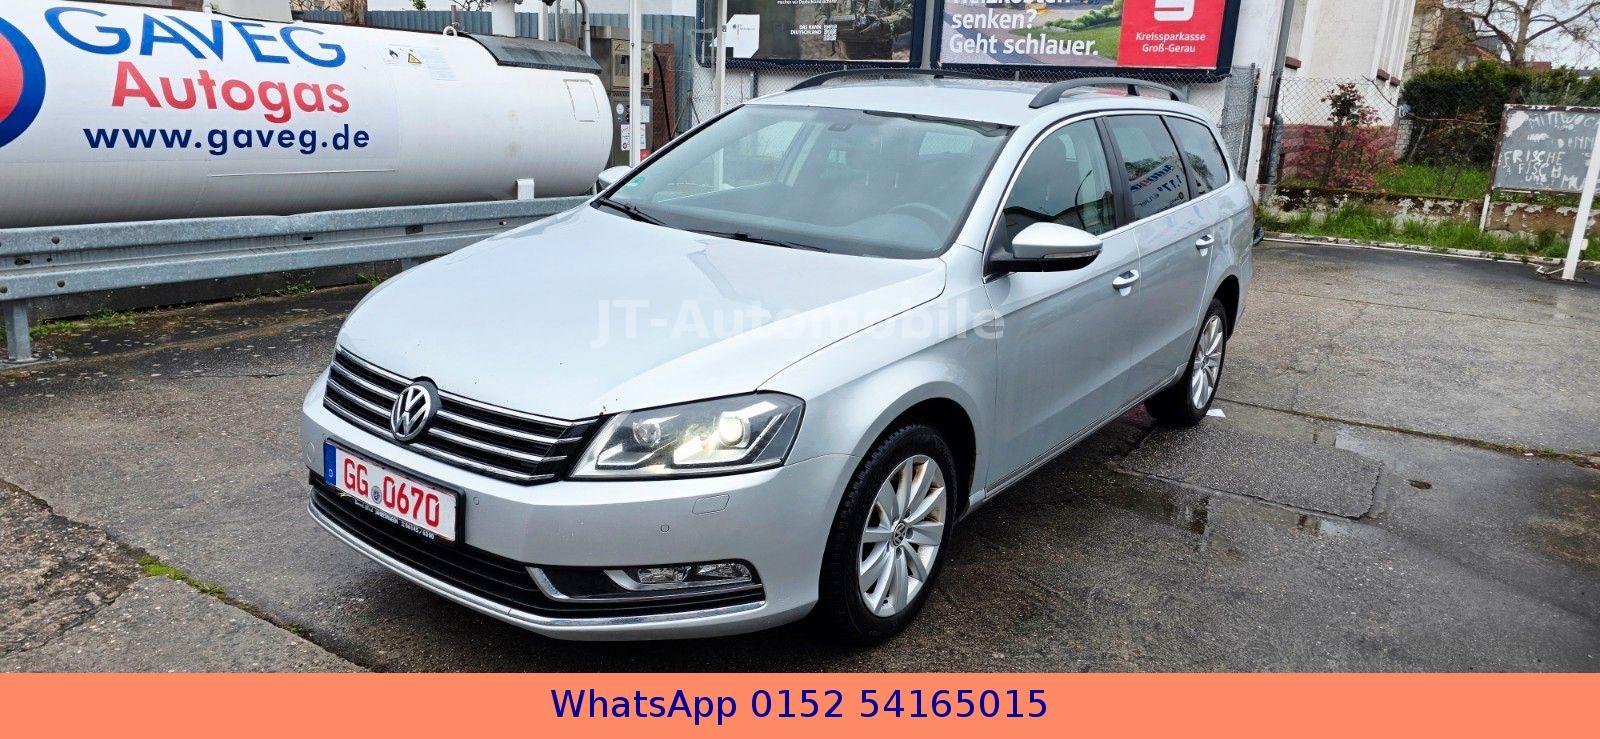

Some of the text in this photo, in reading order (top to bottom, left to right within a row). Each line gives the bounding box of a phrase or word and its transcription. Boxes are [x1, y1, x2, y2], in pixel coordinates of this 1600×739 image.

[951, 8, 1037, 29] senken?
[45, 7, 346, 68] GAVEG
[949, 33, 1099, 56] Geht schlauer.
[1136, 32, 1206, 42] Kreissparkasse
[1142, 43, 1196, 53] Groß-Gerau
[112, 61, 349, 124] Autogas
[83, 124, 370, 155] www.gaveg.de
[344, 458, 369, 497] GG
[383, 475, 440, 528] 0670
